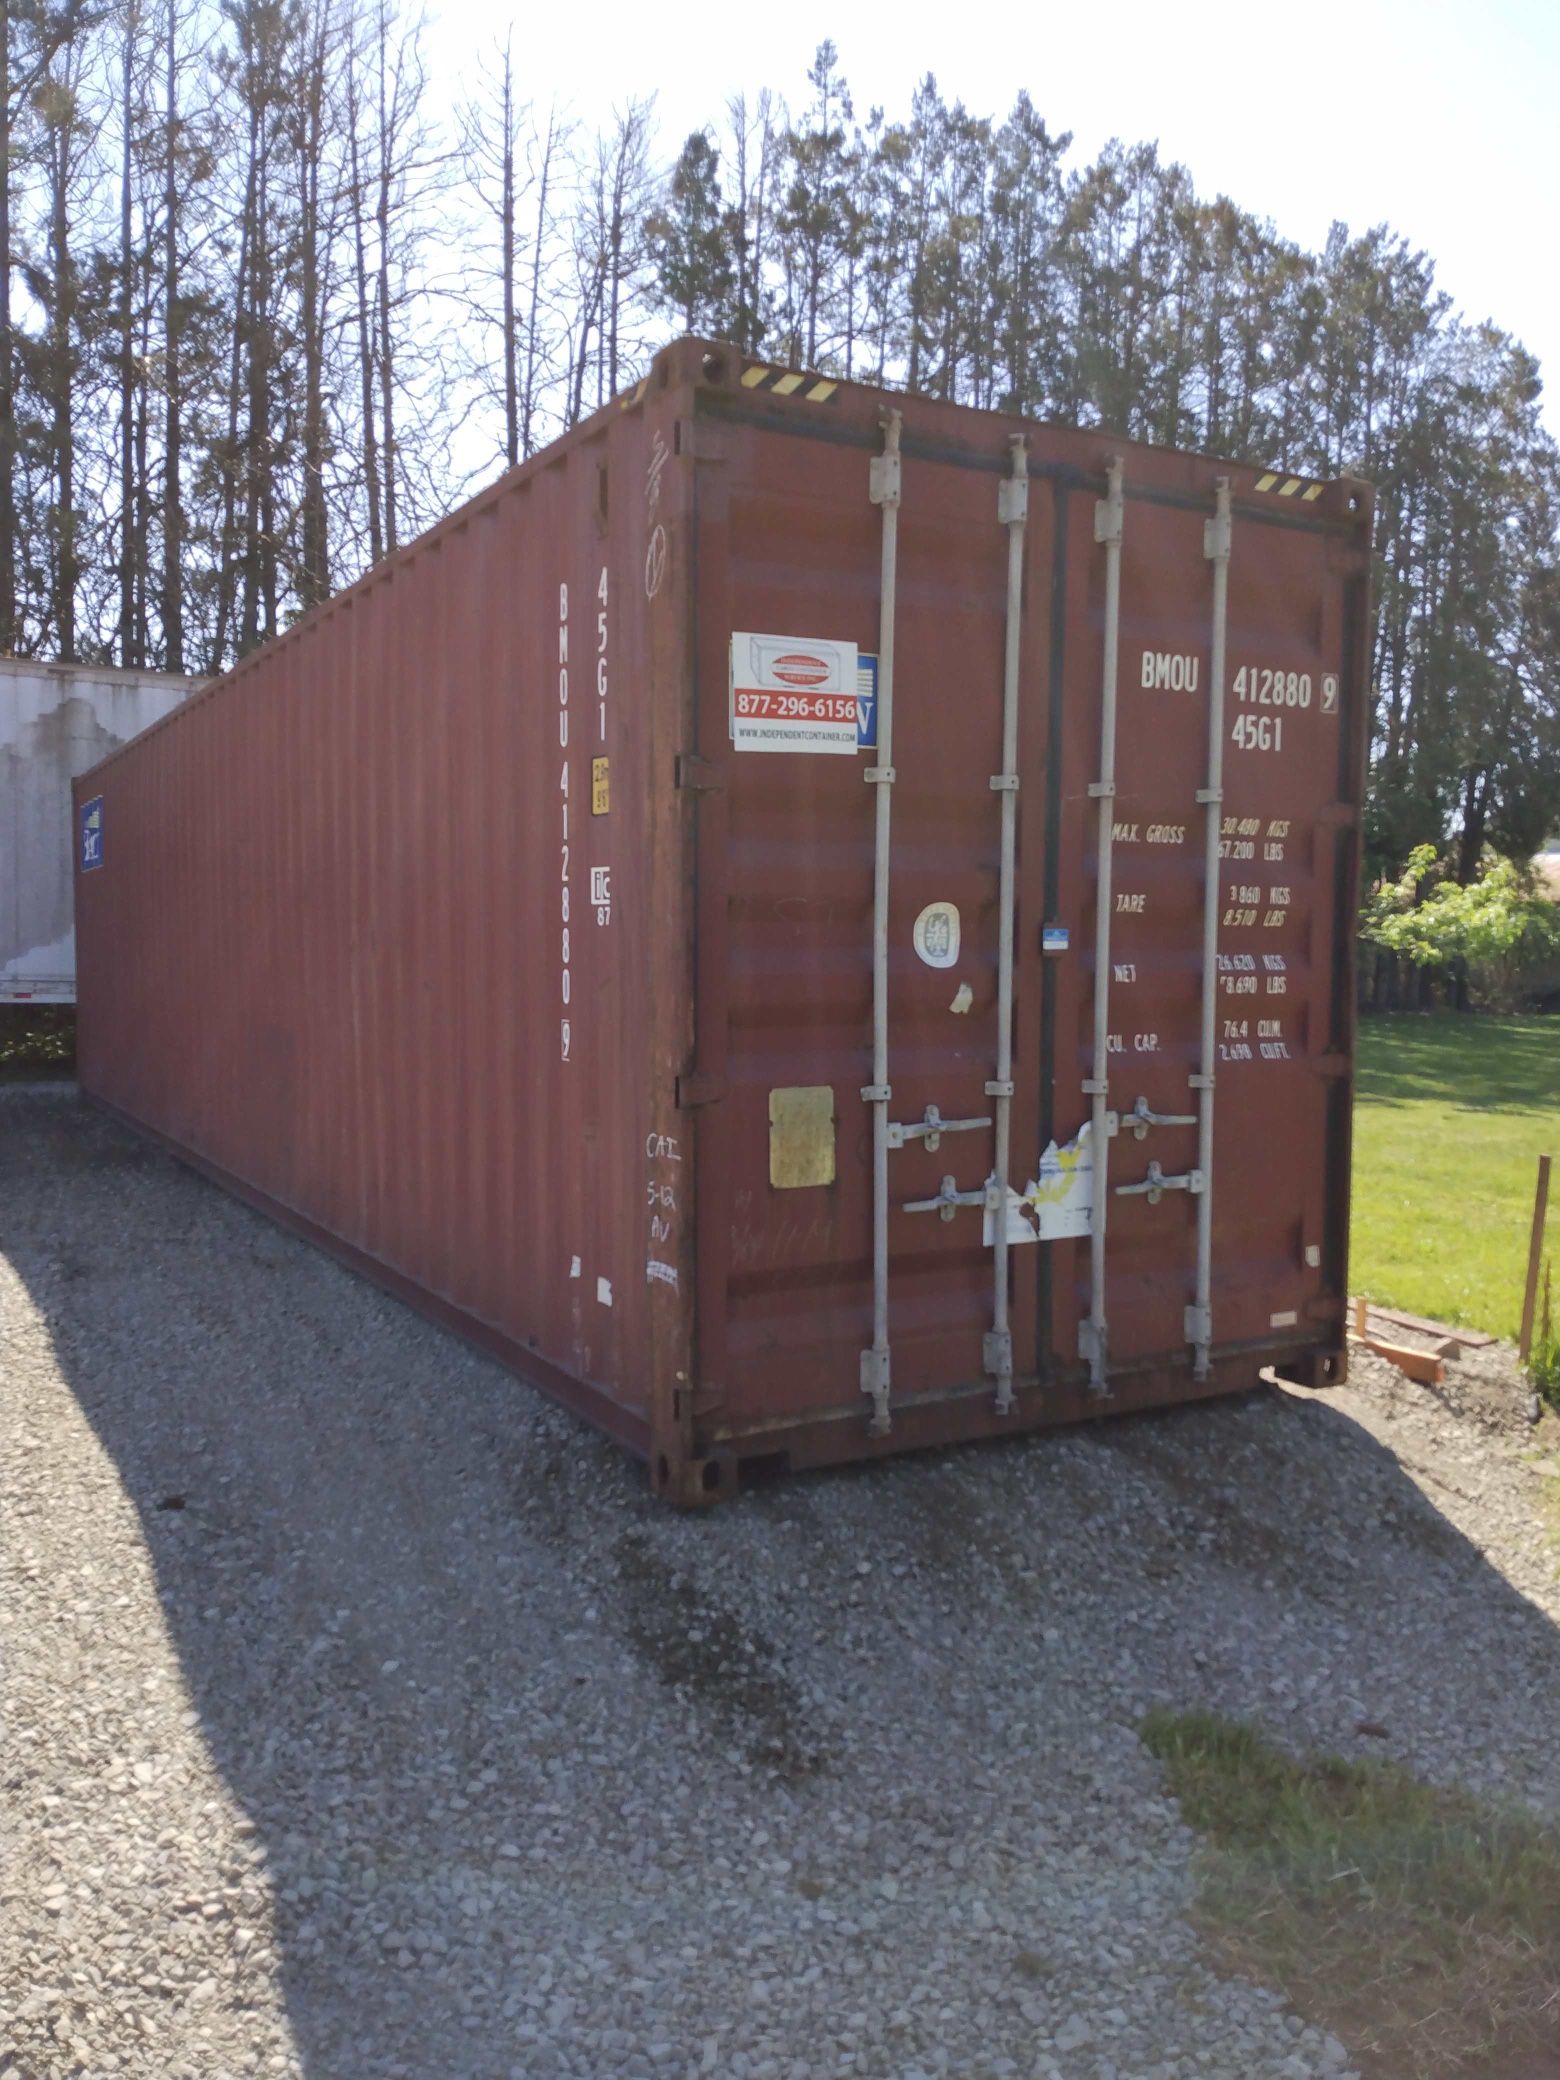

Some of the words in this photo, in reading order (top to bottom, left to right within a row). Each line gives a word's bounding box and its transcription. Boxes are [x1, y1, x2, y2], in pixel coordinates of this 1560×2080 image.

[597, 566, 609, 741] 45G1
[1141, 651, 1199, 692] BMOU
[1232, 665, 1312, 708] 412880
[1322, 676, 1338, 710] 9
[737, 694, 857, 719] 877-296-6156
[738, 727, 856, 743] WWW.INDEPENDENTCONTAINER.COM
[1231, 714, 1282, 751] 45G1
[1146, 825, 1186, 844] GROSS
[1266, 820, 1291, 837] KGS
[1264, 843, 1285, 860] LBS
[1116, 894, 1146, 913] TARE
[1270, 886, 1291, 905] KGS
[597, 906, 611, 926] 87
[1263, 910, 1287, 927] LBS
[1114, 964, 1137, 983] NET
[1266, 976, 1287, 994] LBS
[1223, 1020, 1249, 1038] 76.4
